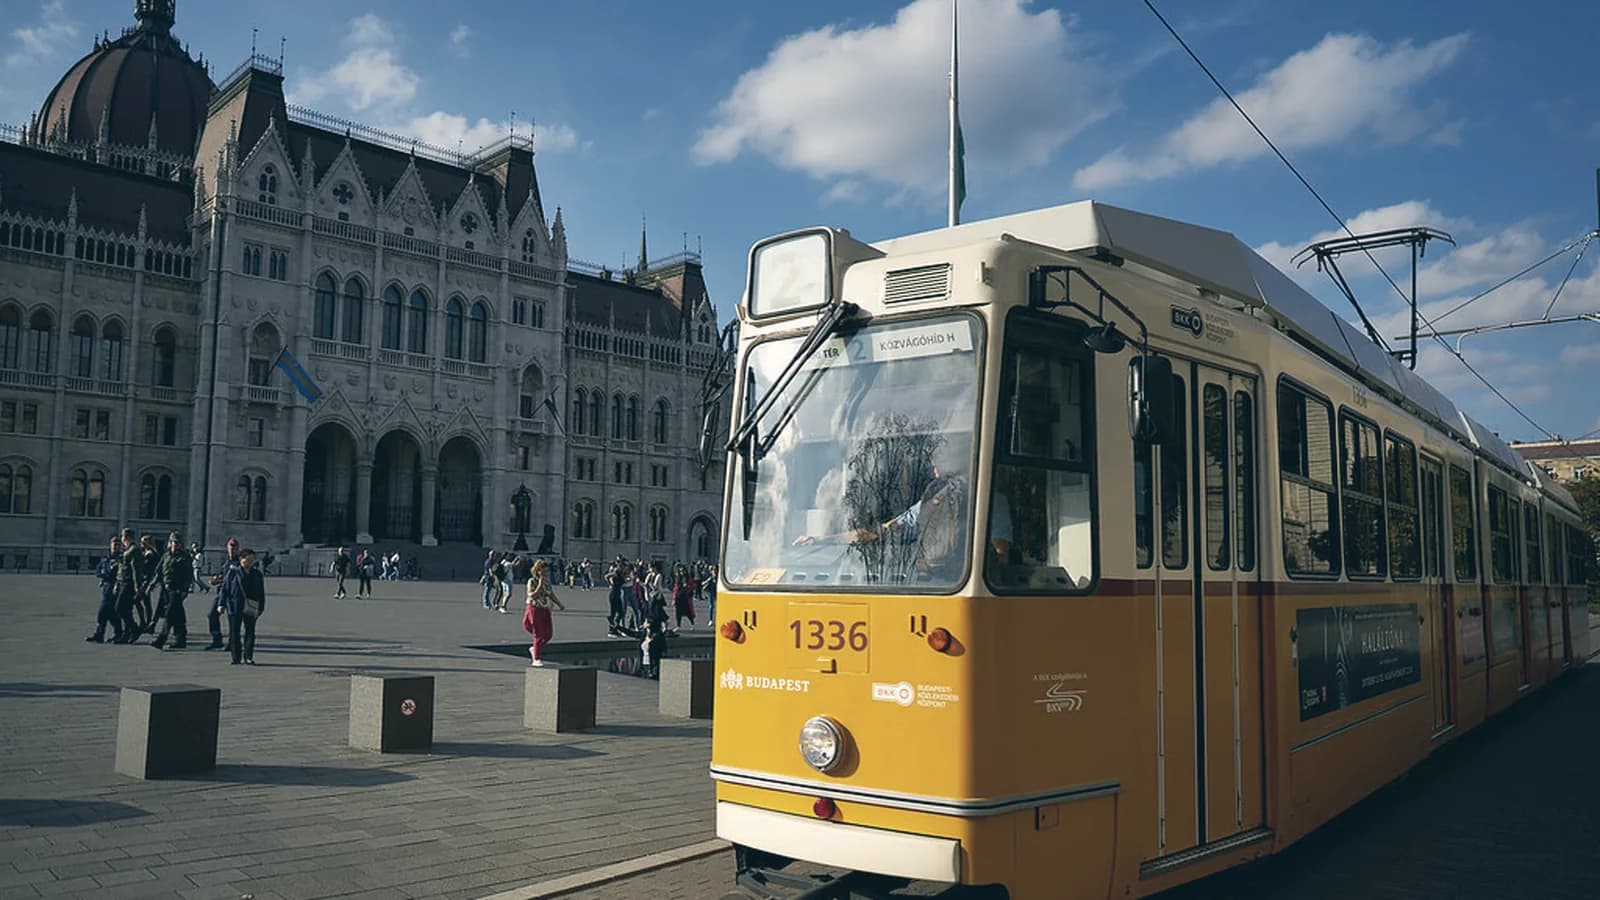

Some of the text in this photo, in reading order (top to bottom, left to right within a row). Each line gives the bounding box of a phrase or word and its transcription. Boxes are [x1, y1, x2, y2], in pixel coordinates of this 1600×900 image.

[946, 331, 956, 343] H
[851, 339, 867, 361] 2
[790, 620, 868, 652] 1336
[745, 675, 810, 692] BUDAPEST
[877, 688, 897, 697] BKK
